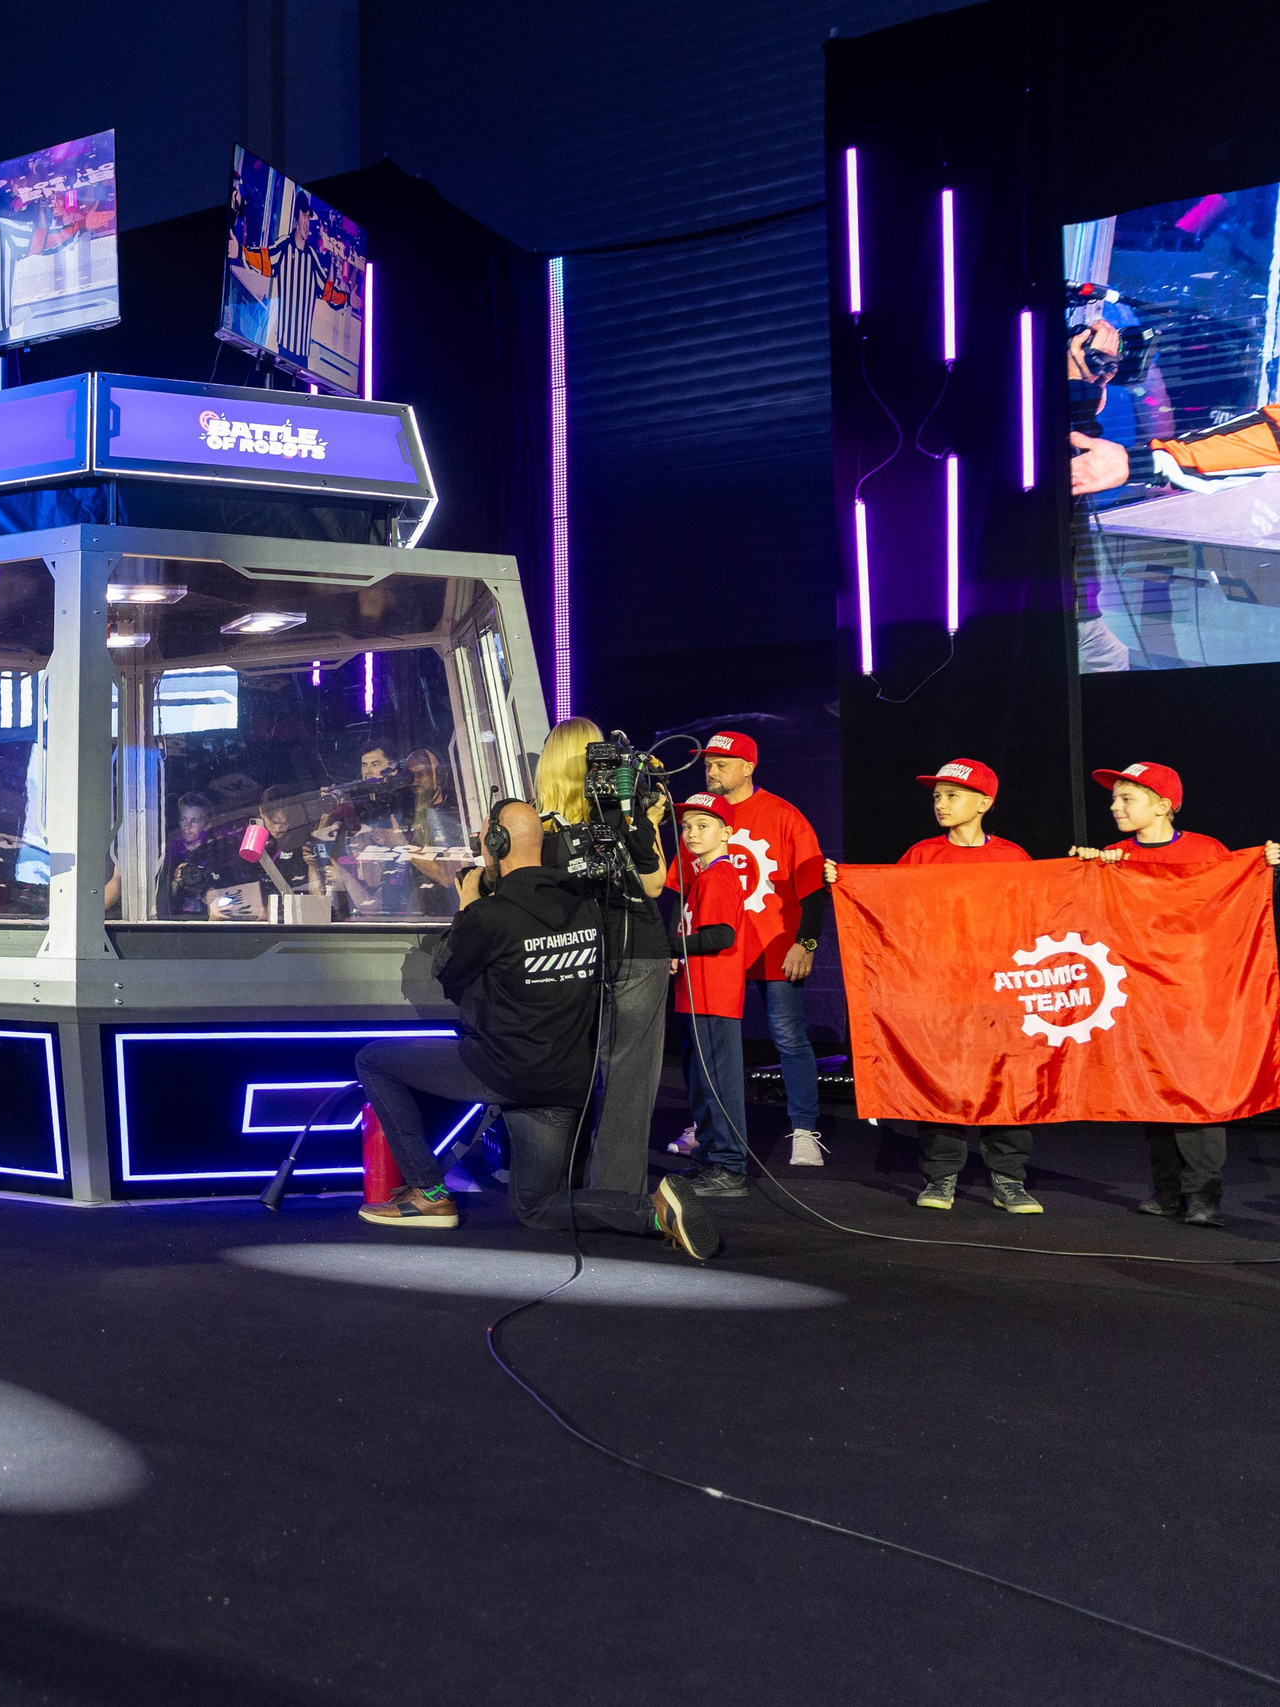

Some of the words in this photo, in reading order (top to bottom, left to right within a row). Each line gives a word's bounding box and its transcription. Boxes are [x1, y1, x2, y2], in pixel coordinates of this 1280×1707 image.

[206, 419, 319, 445] BATTLE
[205, 434, 236, 451] OF
[239, 438, 326, 460] ROBOTS
[523, 928, 597, 952] ОРГАНИЗАТОР
[994, 963, 1088, 992] ATOMIC
[1017, 987, 1092, 1013] TEAM
